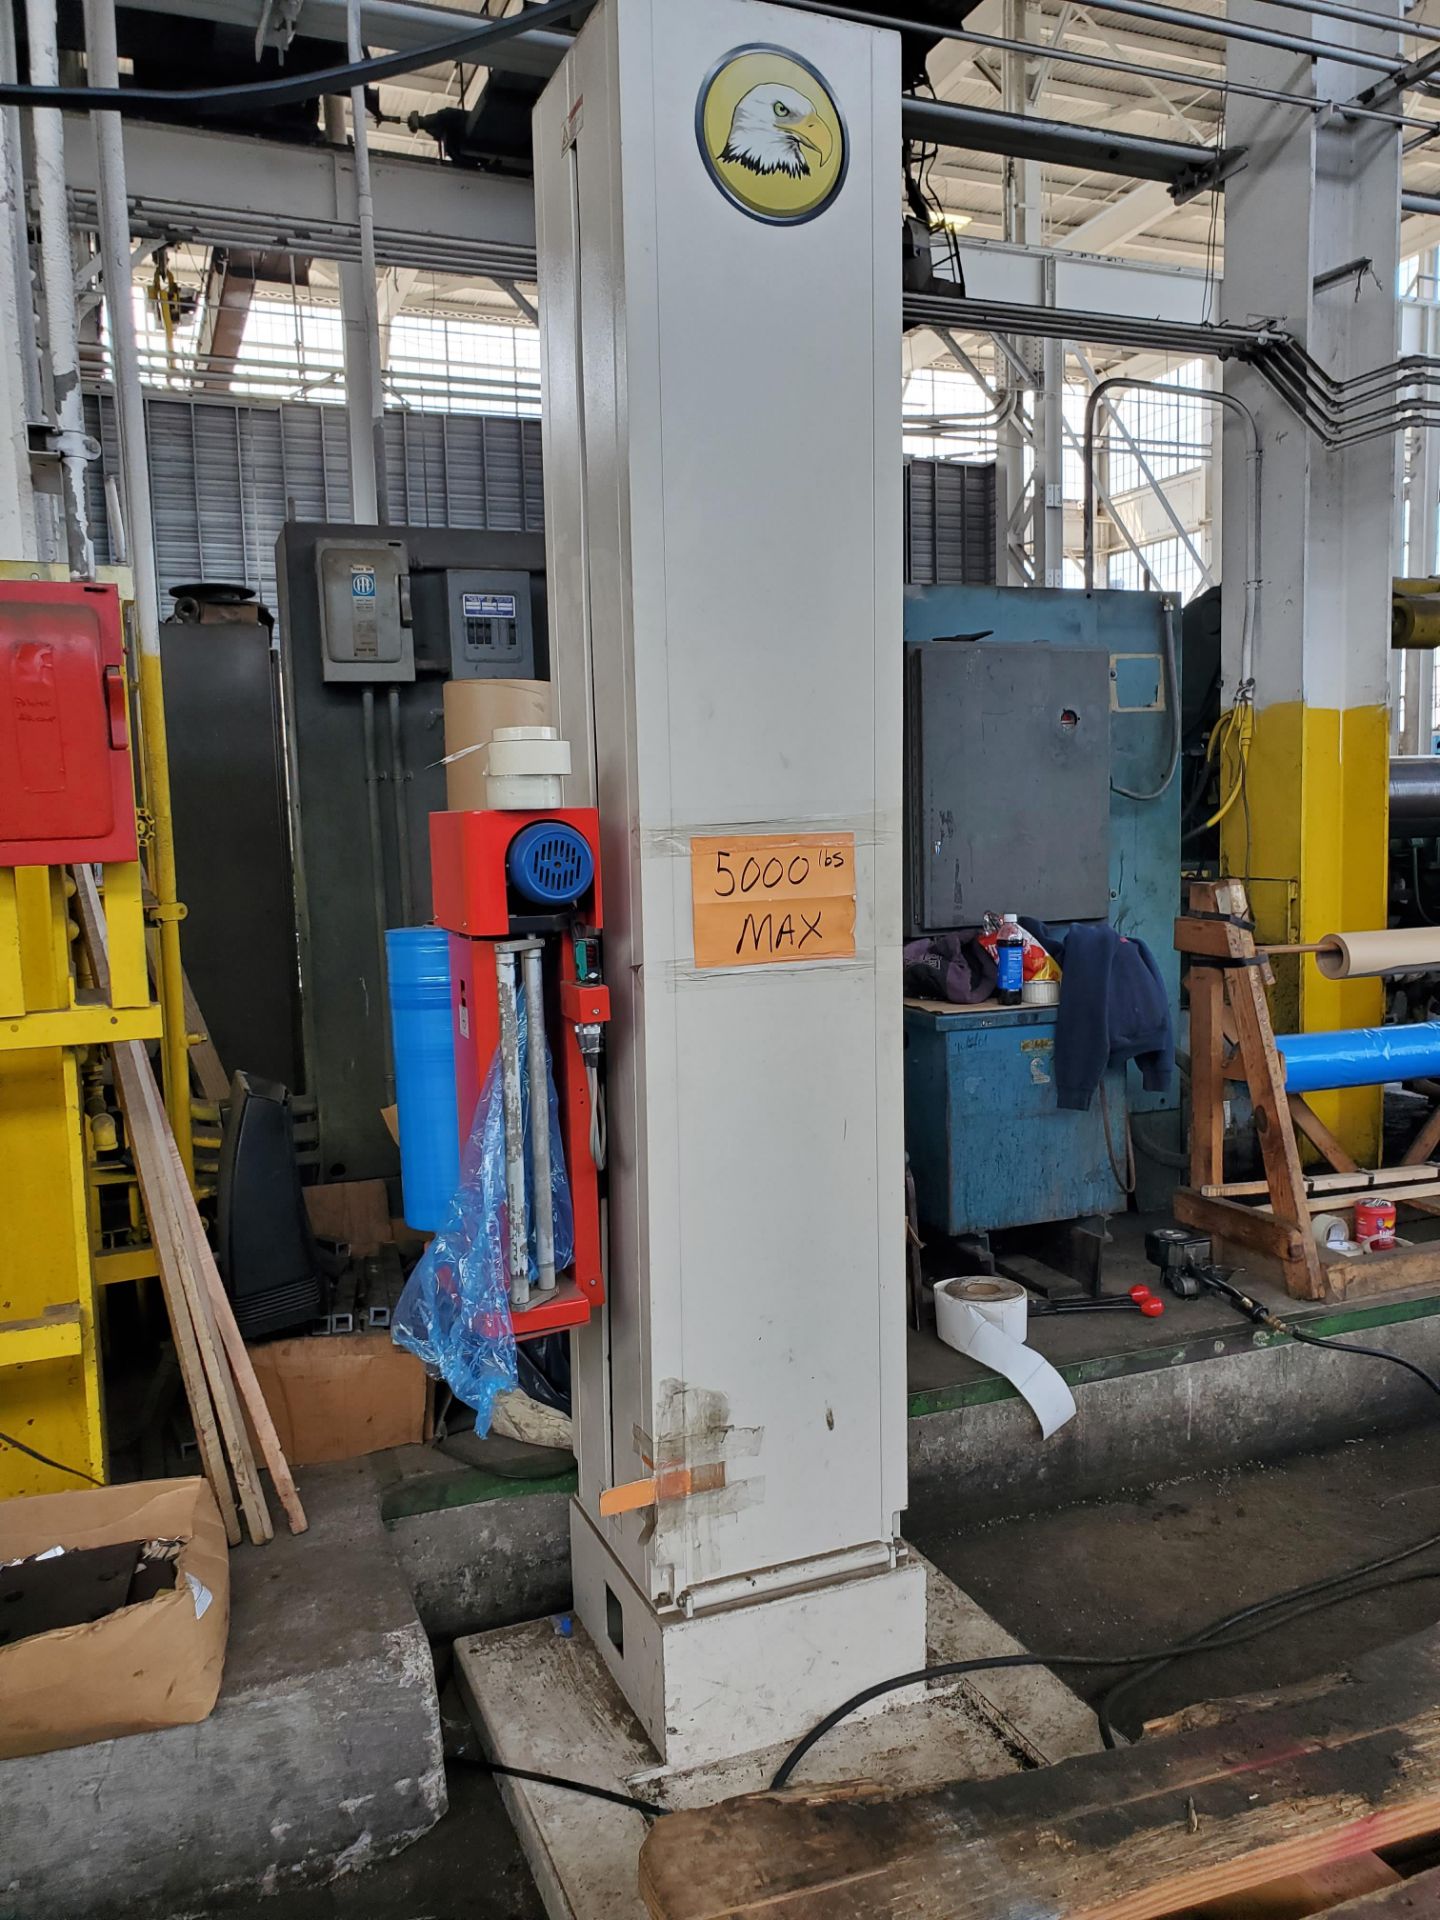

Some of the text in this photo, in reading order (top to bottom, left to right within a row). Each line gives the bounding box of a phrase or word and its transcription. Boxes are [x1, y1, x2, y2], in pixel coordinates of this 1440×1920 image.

[714, 849, 845, 897] 5000 lbs
[736, 911, 823, 955] MAX
